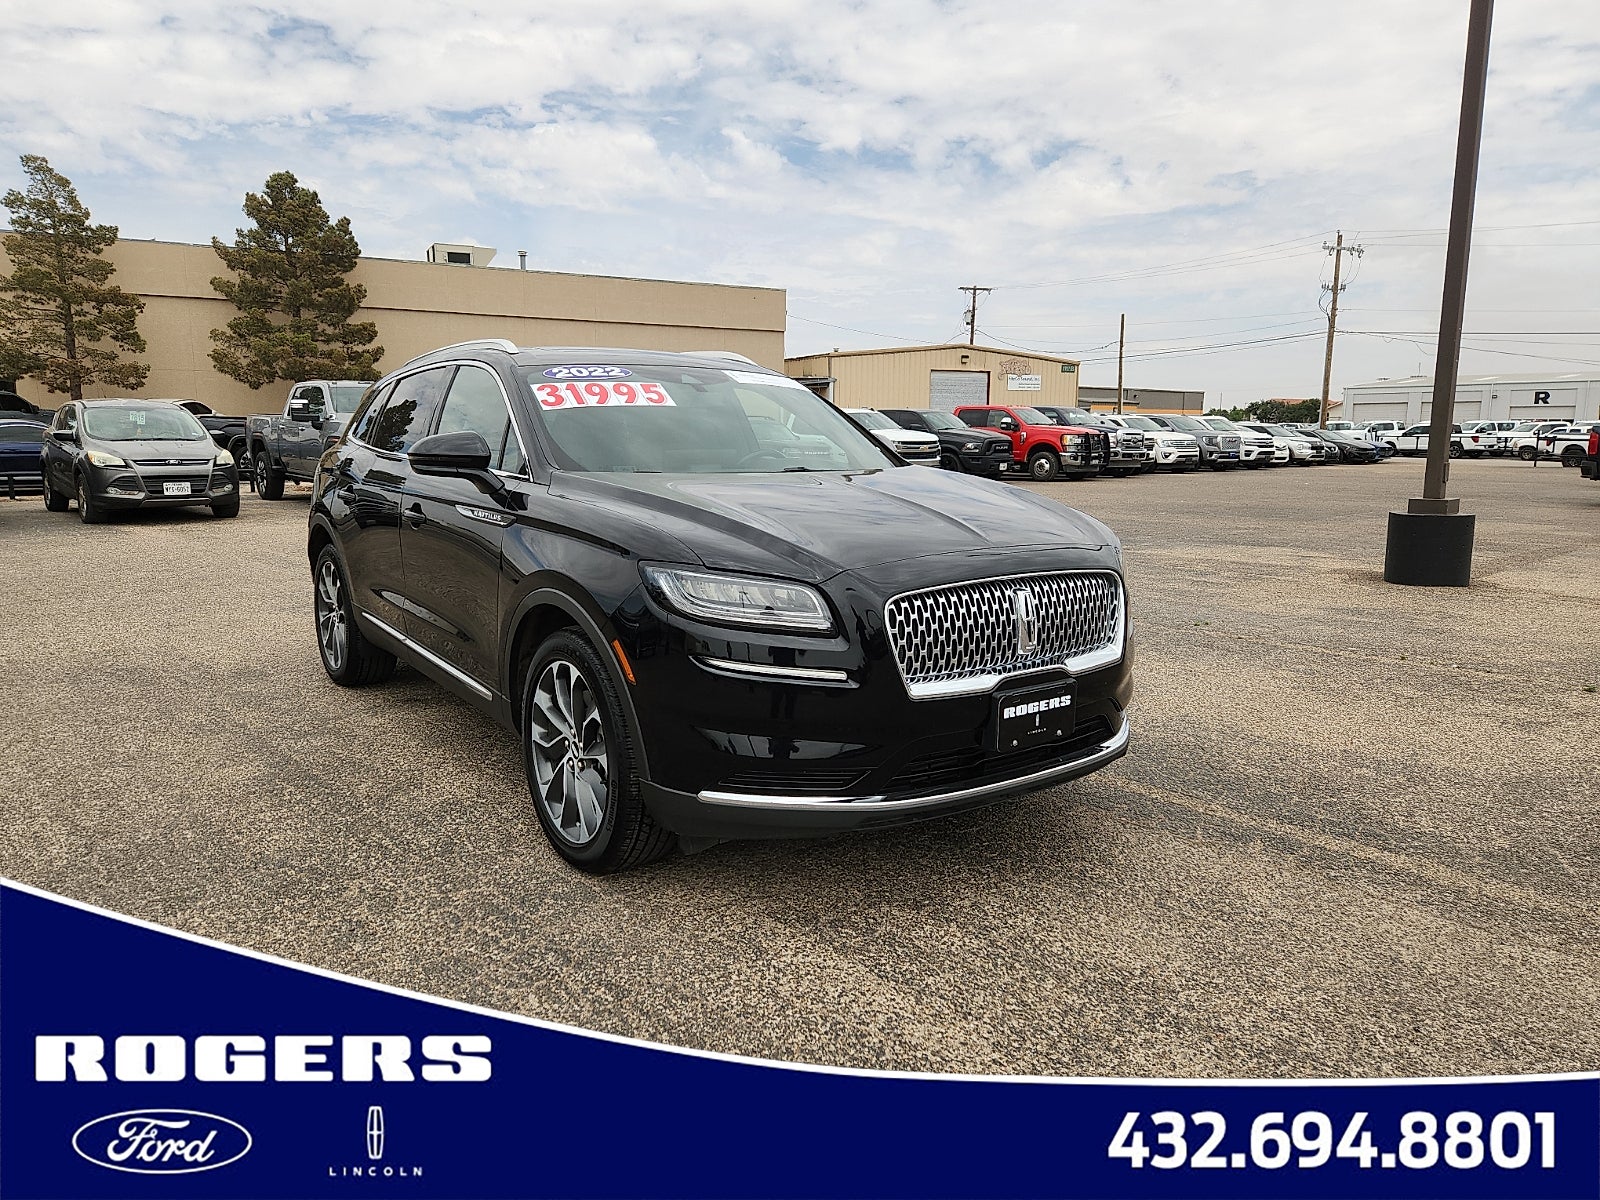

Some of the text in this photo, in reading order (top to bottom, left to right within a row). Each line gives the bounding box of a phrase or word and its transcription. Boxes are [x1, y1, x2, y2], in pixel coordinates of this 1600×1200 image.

[551, 366, 624, 378] 2022
[536, 382, 668, 408] 31995
[1533, 391, 1551, 405] R
[473, 510, 502, 521] NAUTILUS
[1003, 694, 1072, 720] ROGERS
